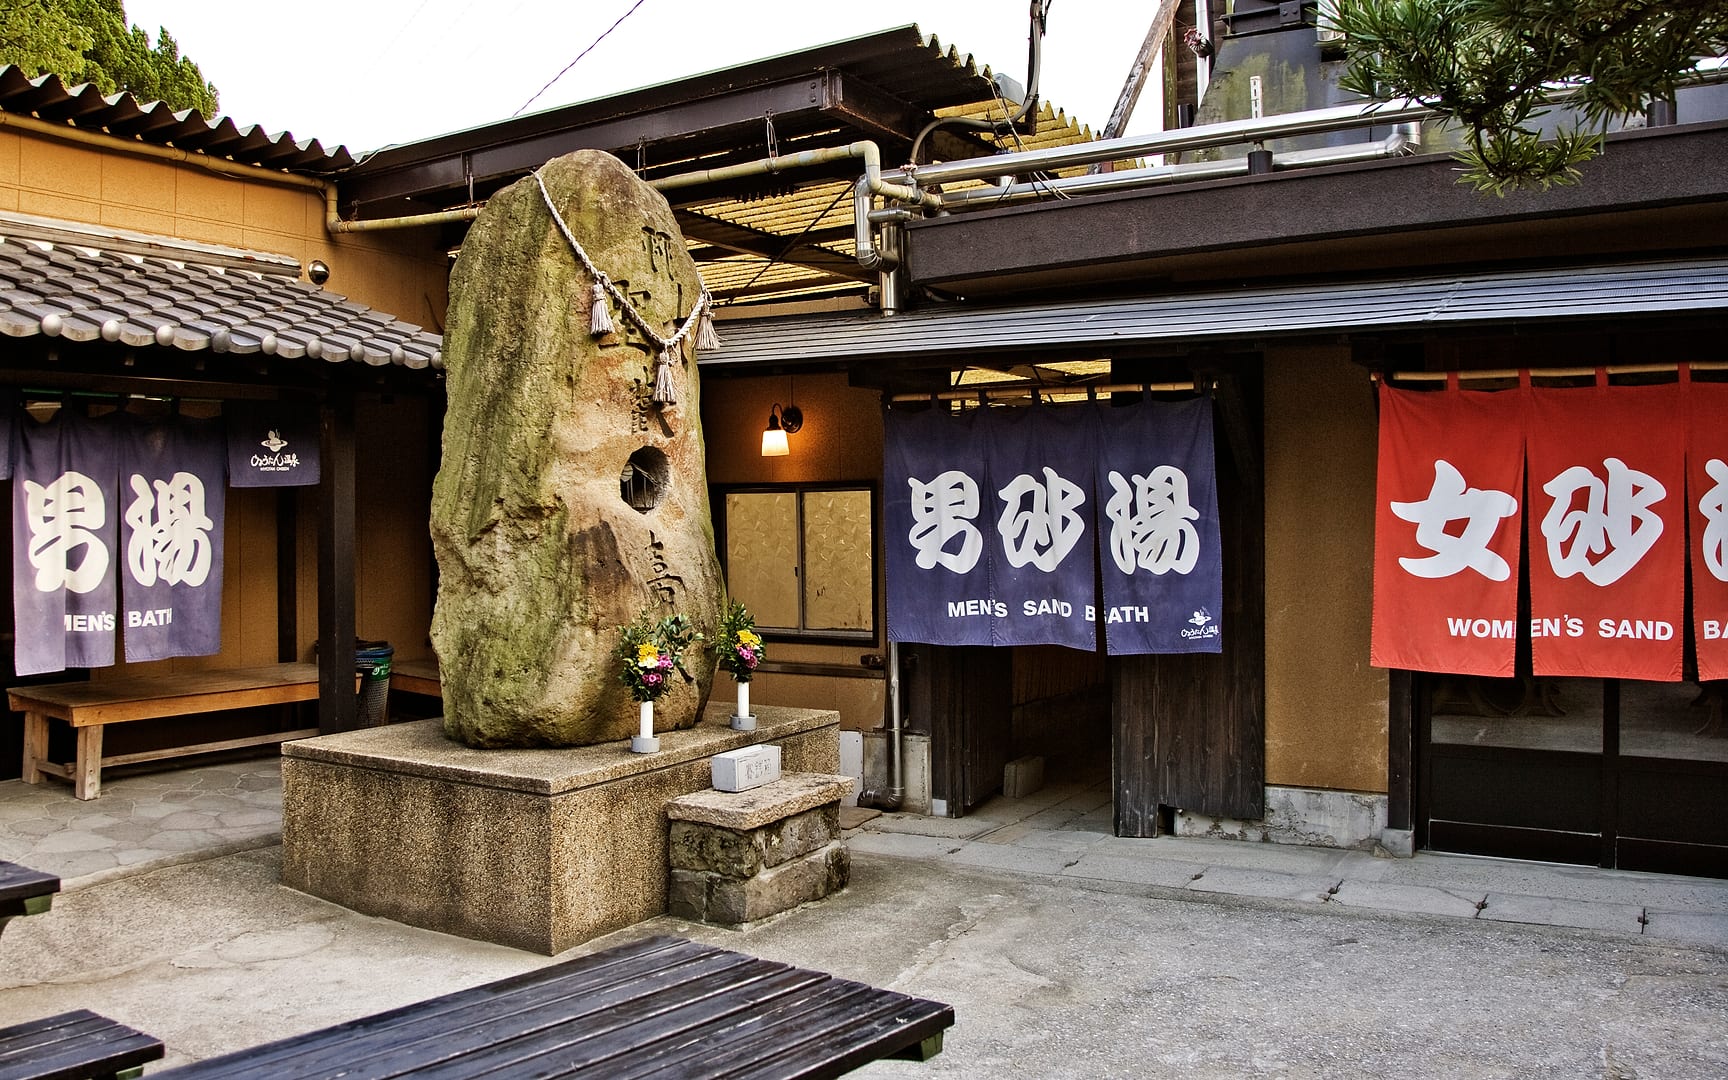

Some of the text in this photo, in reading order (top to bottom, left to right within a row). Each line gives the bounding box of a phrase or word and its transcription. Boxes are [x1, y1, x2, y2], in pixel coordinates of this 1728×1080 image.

[23, 471, 214, 593] 男湯
[1023, 599, 1072, 618] SAND
[1085, 605, 1149, 624] BATH
[1598, 619, 1674, 641] SAND
